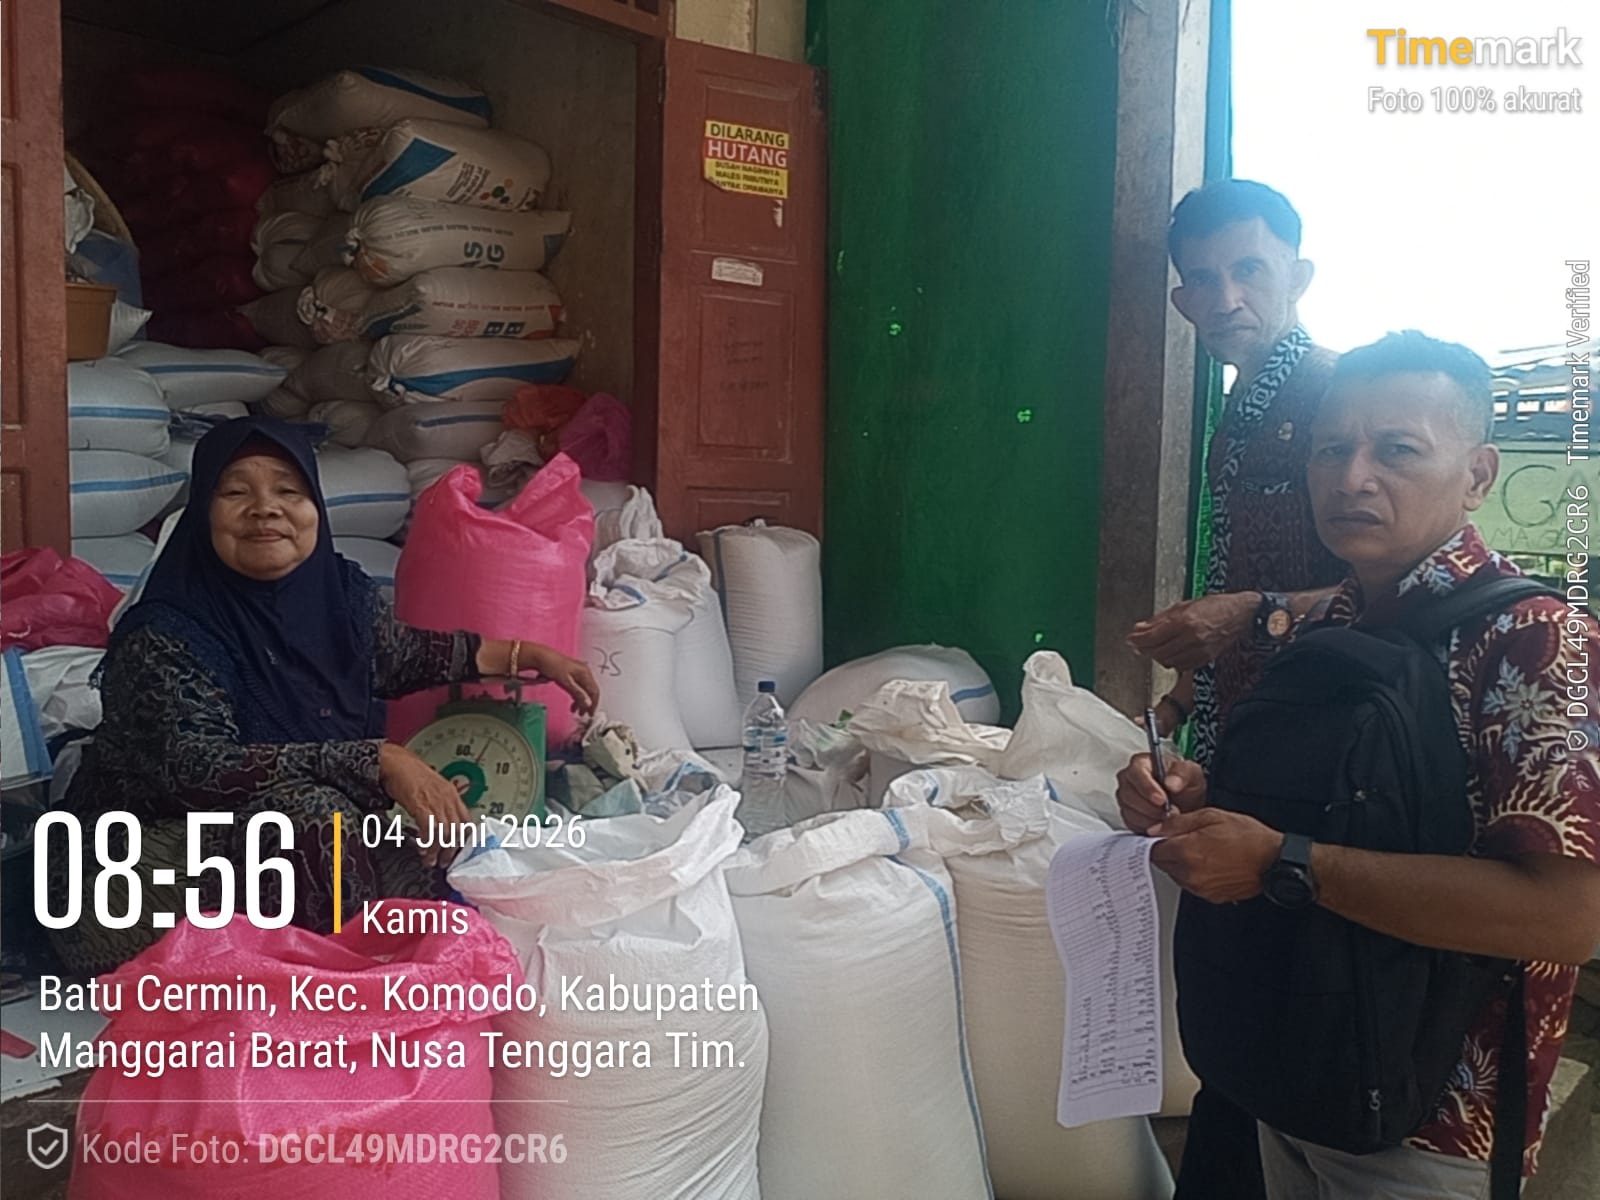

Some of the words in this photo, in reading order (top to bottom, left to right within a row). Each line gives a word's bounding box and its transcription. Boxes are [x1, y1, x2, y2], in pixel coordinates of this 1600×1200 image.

[710, 124, 785, 147] DILARANG
[708, 140, 787, 167] HUTANG
[495, 762, 510, 775] 10
[489, 802, 505, 814] 20
